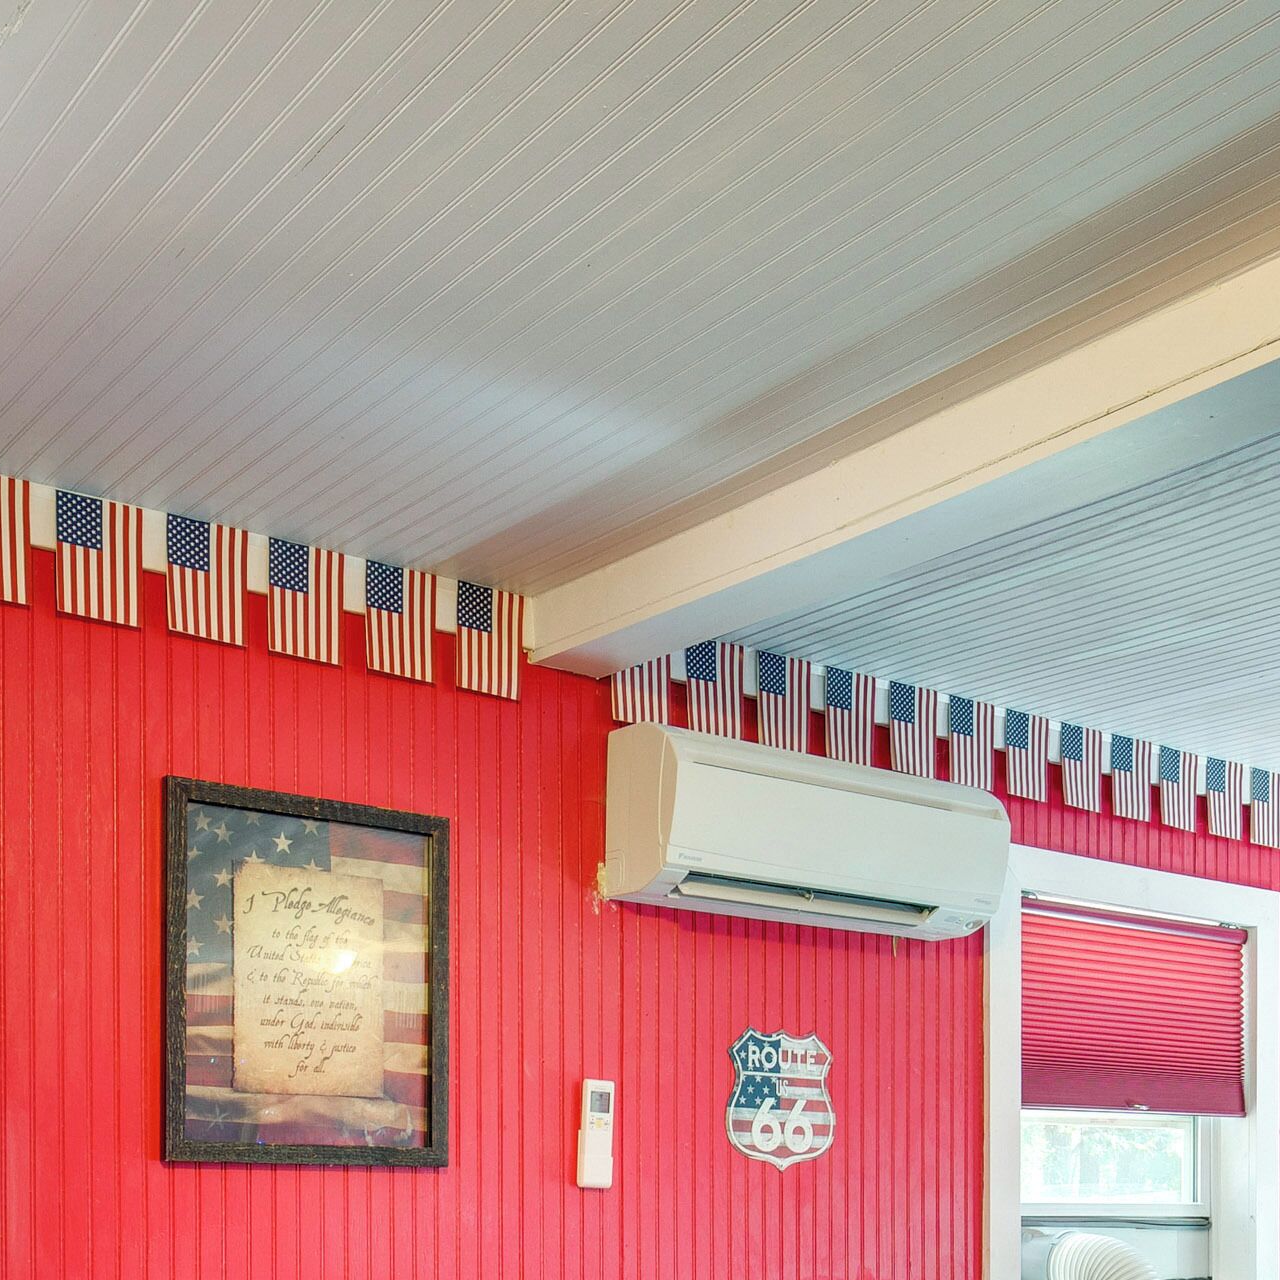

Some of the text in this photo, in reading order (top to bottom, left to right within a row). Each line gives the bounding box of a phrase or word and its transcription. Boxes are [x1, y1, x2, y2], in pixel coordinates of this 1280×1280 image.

[262, 887, 312, 919] Pledge
[311, 894, 375, 926] Allegiance
[272, 928, 280, 938] to
[285, 925, 301, 940] the
[247, 943, 292, 960] United
[260, 972, 268, 981] to
[273, 968, 289, 983] the
[260, 1009, 284, 1027] under
[321, 1013, 363, 1032] indivisible
[264, 1033, 290, 1049] with
[288, 1031, 315, 1060] liberty
[323, 1043, 357, 1060] justice
[748, 1045, 817, 1071] ROUTE
[288, 1060, 308, 1078] for
[775, 1079, 789, 1097] US
[752, 1097, 813, 1153] 66
